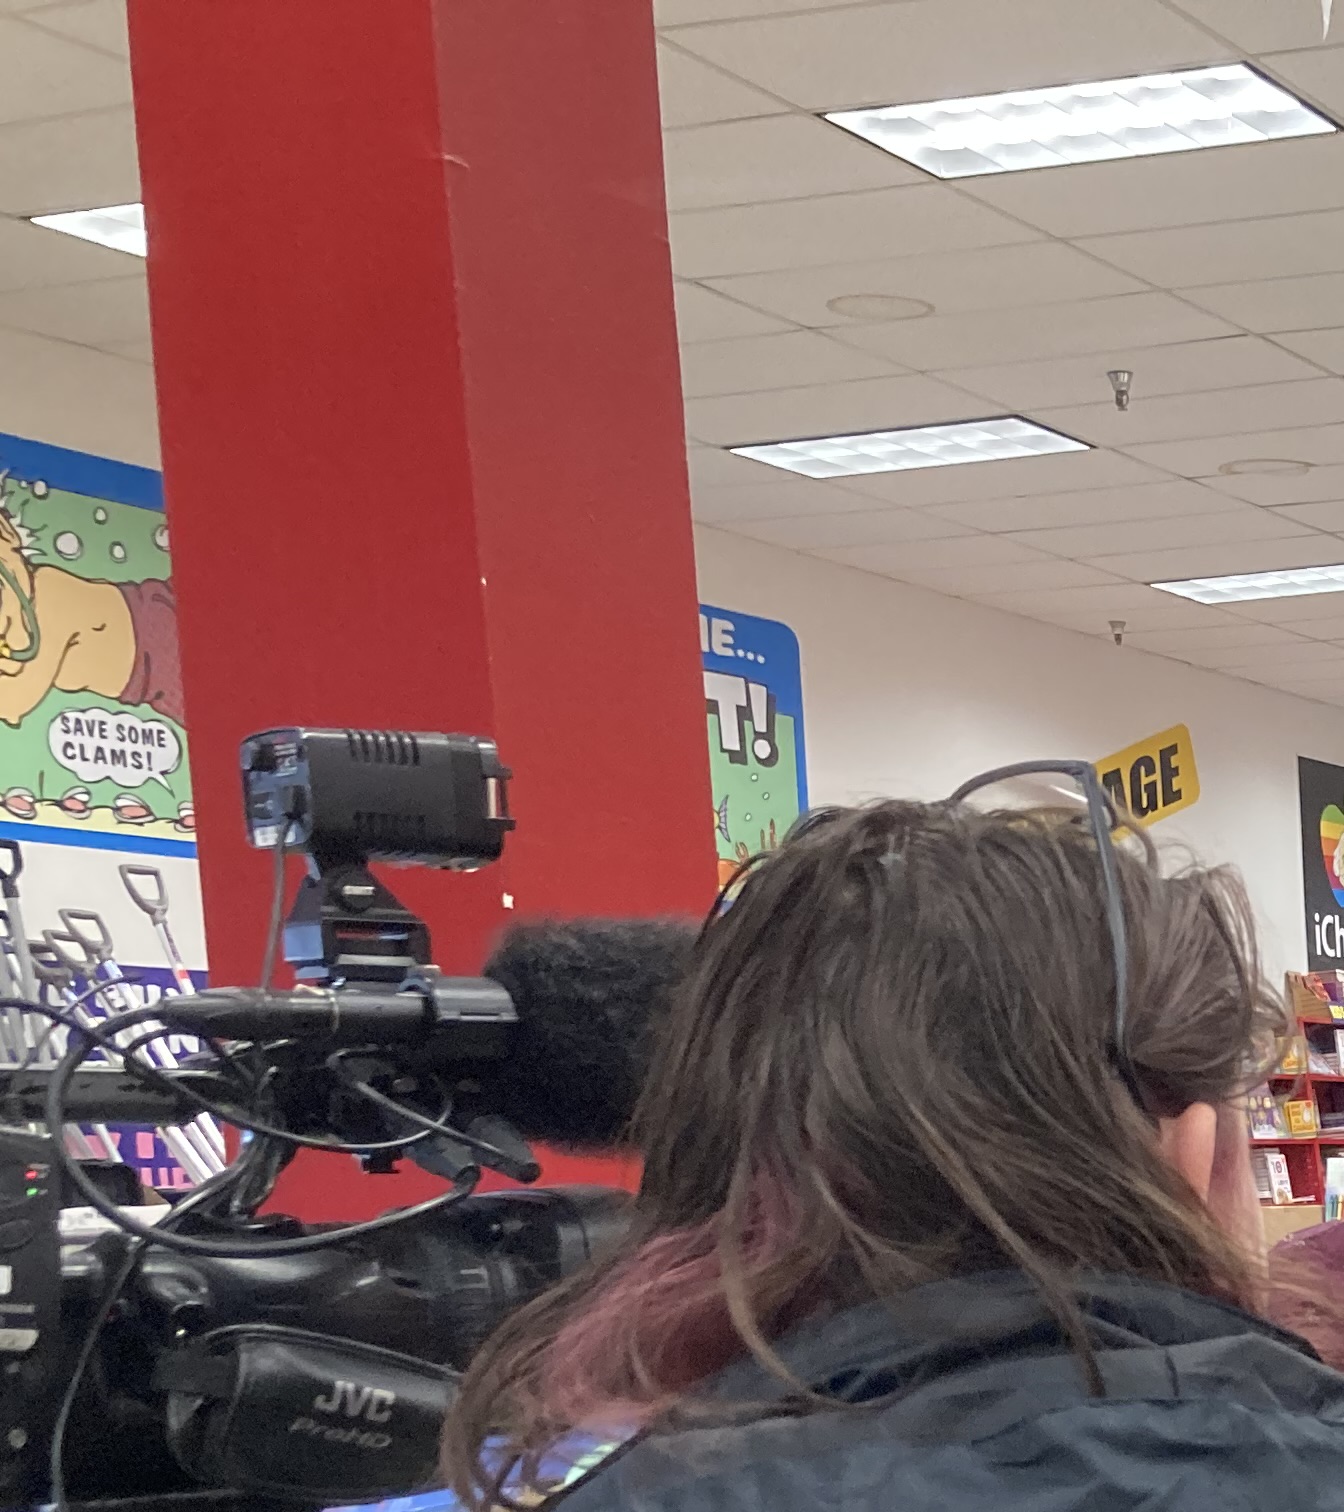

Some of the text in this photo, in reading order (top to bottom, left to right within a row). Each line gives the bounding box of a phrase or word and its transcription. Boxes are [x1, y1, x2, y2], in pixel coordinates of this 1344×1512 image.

[60, 714, 166, 748] SAVE SOME
[62, 741, 153, 771] CLAMS!
[314, 1380, 396, 1422] JVC
